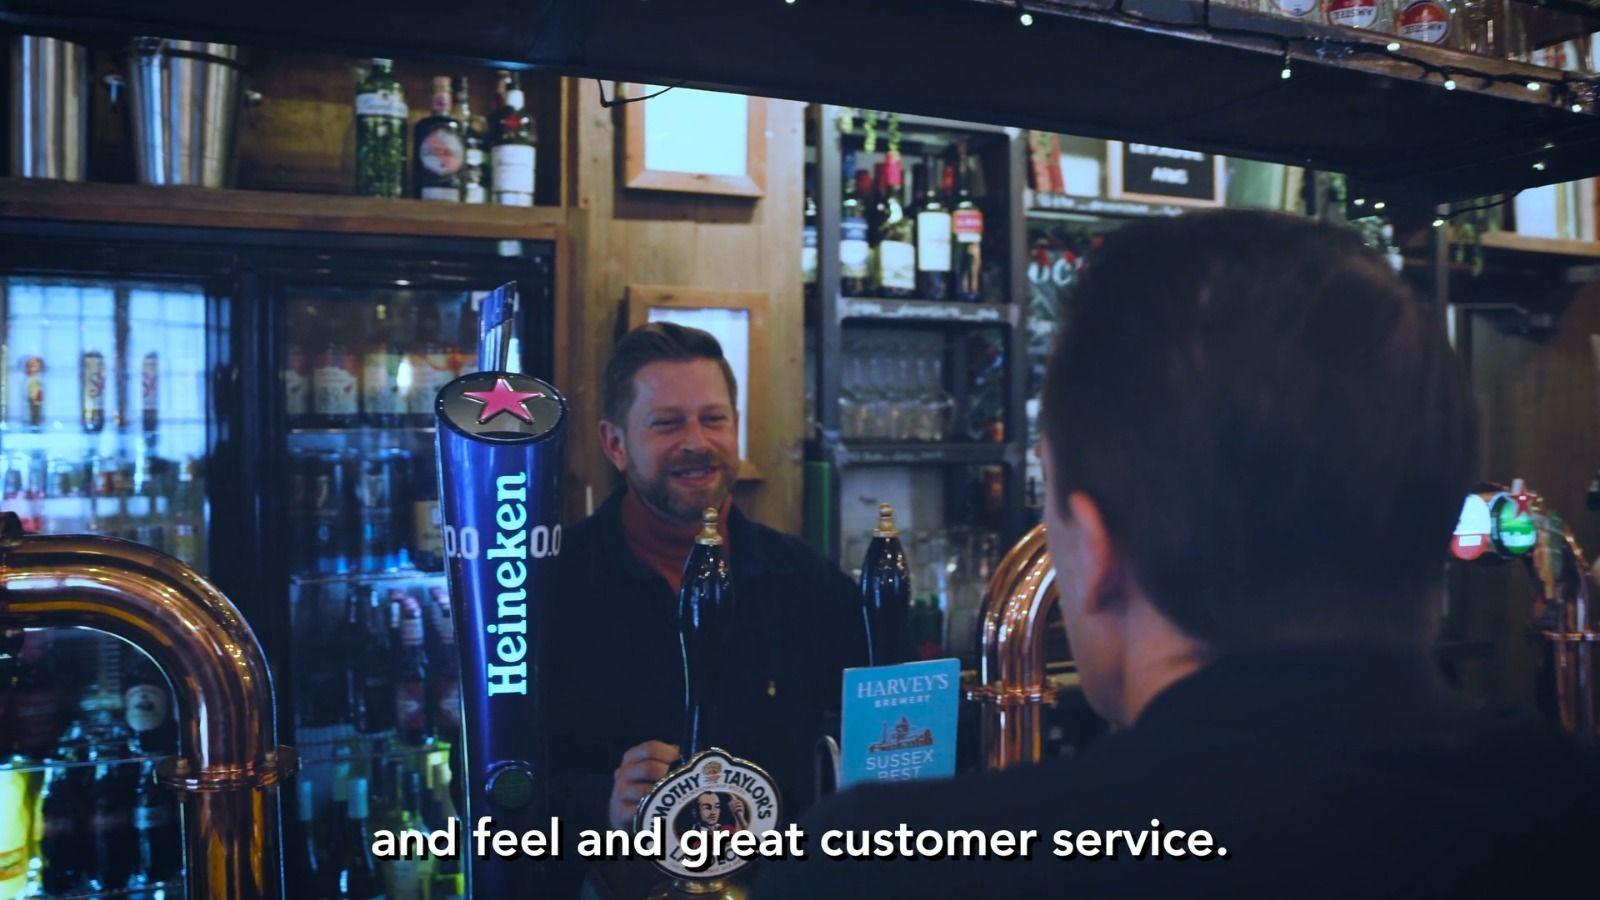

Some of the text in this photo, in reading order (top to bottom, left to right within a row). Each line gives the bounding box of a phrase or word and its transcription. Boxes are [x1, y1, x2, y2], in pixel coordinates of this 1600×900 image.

[444, 524, 480, 561] 0.0
[530, 524, 563, 559] 0.0
[486, 471, 528, 697] Heineken
[857, 673, 950, 699] HARVEY'S
[874, 694, 932, 708] BREWERY
[866, 749, 934, 771] SUSSEX
[650, 773, 701, 832] MOTHY
[723, 769, 771, 820] TAYLOR'S
